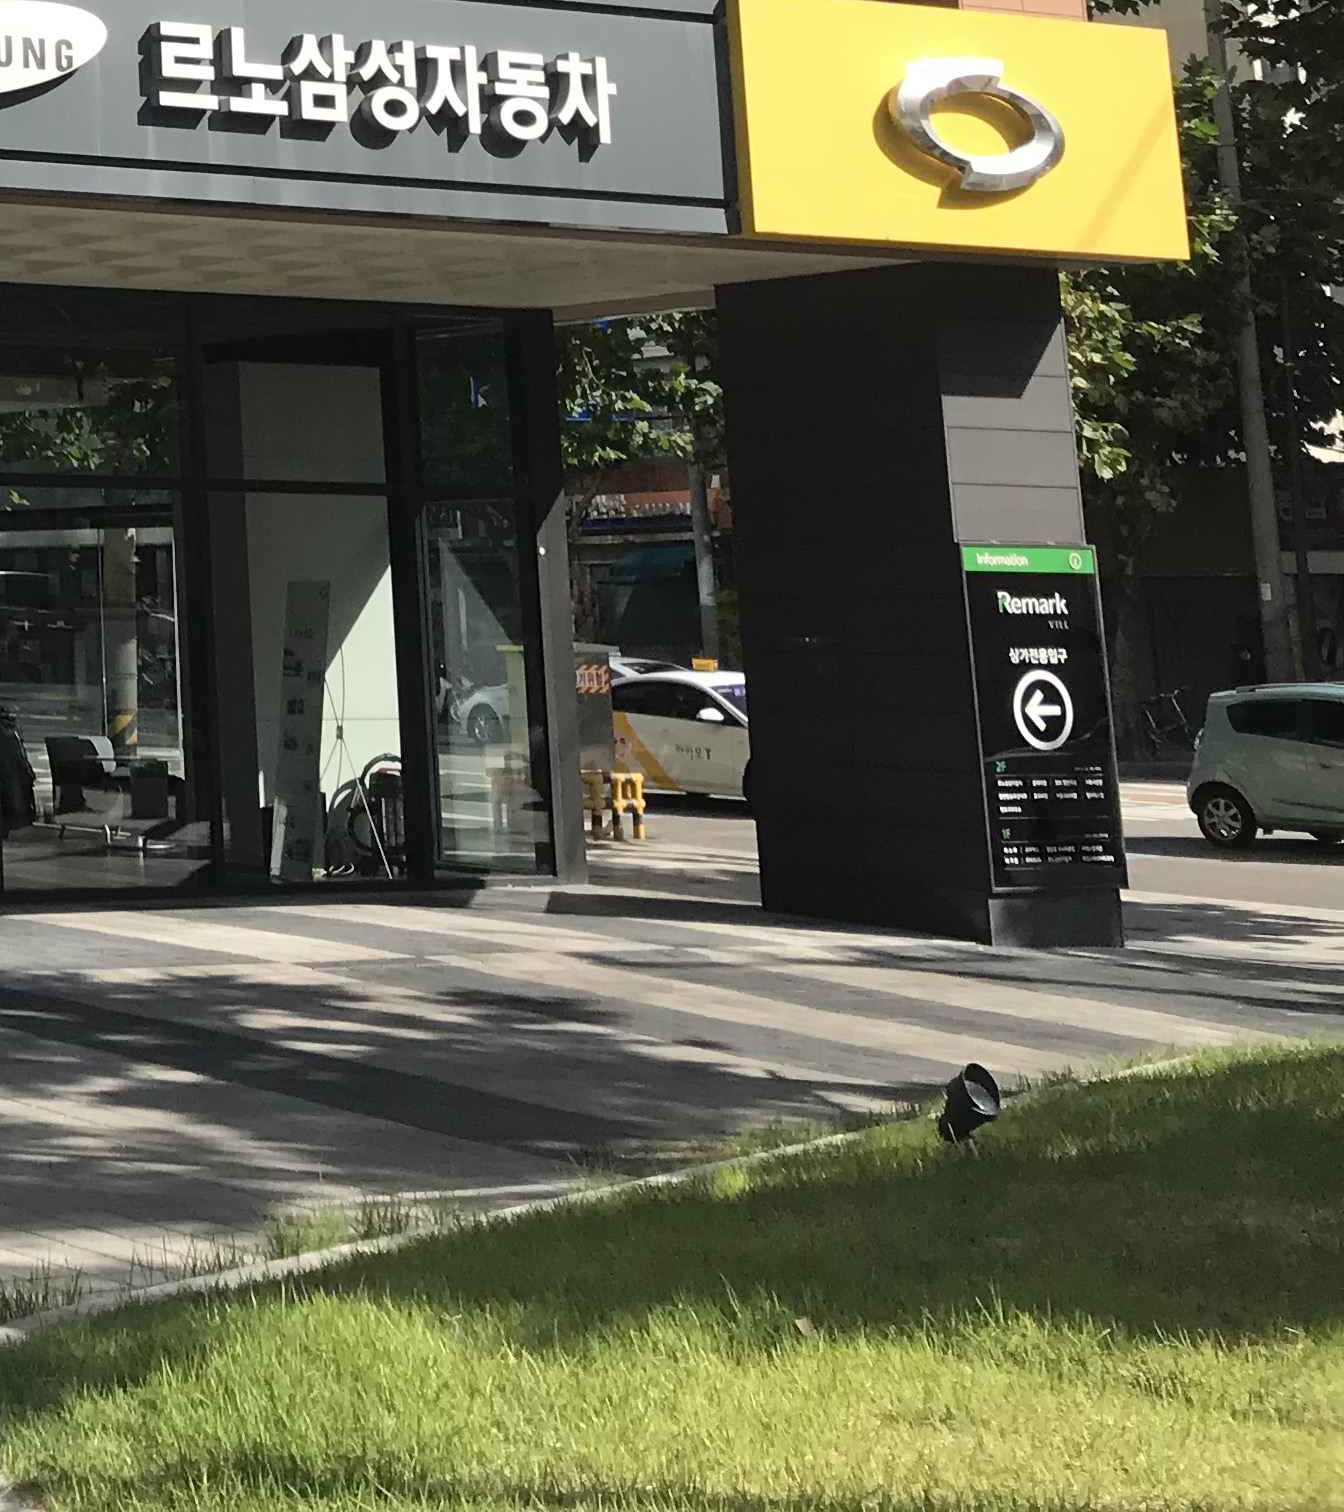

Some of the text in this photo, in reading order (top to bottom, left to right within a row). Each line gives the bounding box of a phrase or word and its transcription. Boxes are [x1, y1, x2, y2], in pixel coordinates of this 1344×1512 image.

[156, 19, 618, 147] 르노삼성자동차
[975, 551, 1029, 567] Information
[996, 590, 1069, 615] Remark
